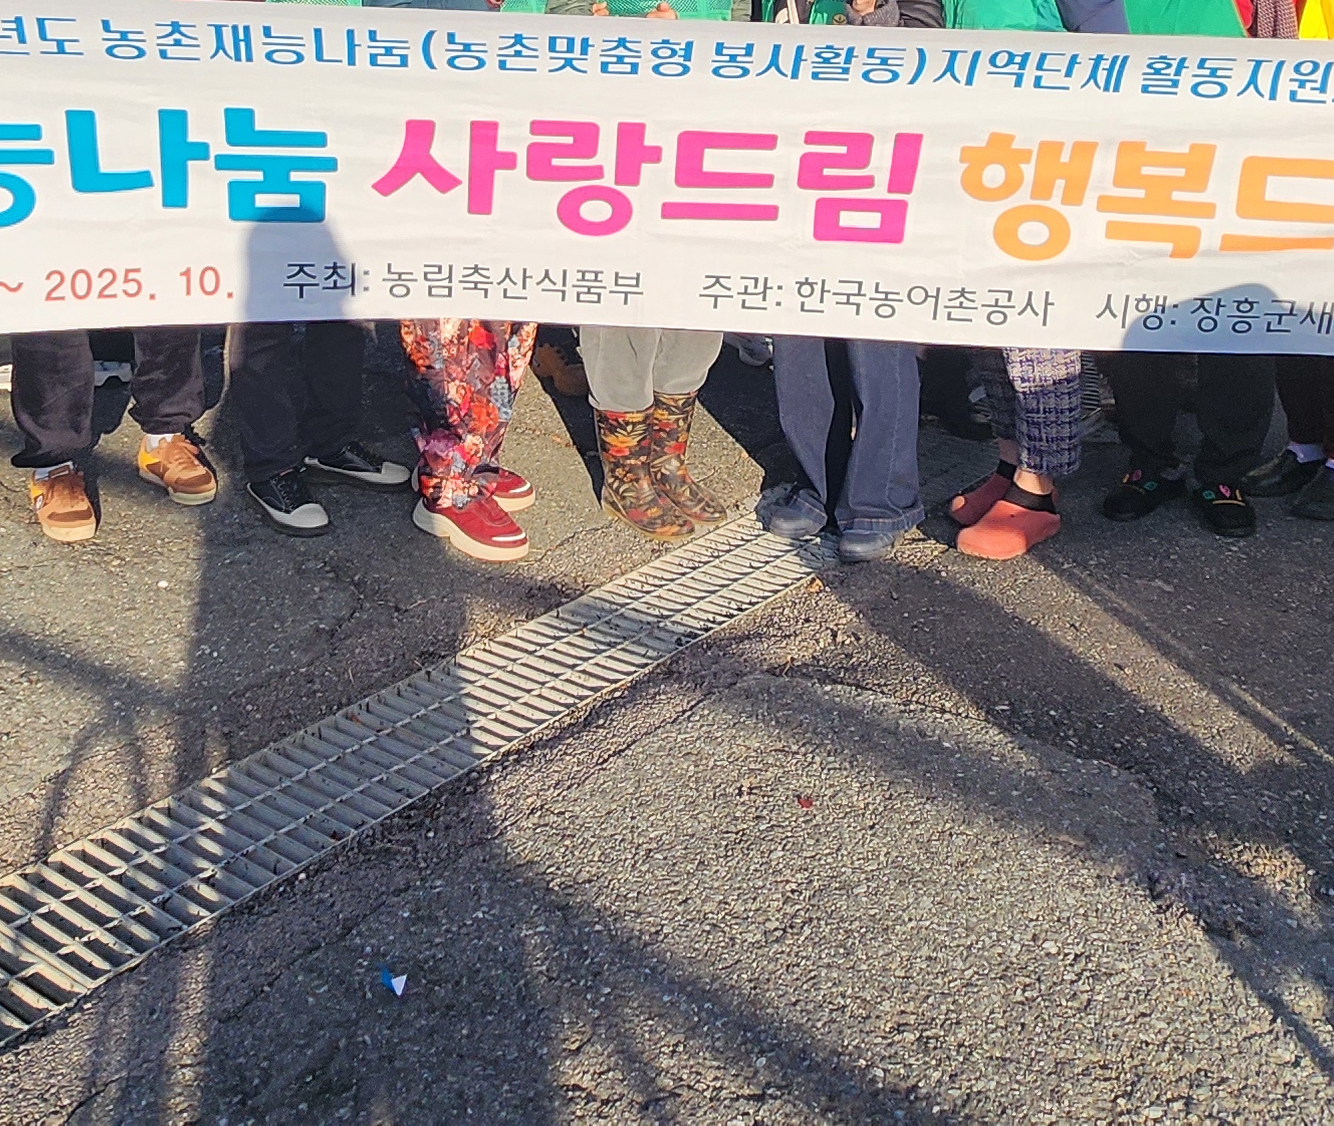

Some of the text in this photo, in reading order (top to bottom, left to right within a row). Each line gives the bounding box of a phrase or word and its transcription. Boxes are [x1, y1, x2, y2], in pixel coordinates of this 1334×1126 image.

[371, 119, 924, 245] 사랑드림
[44, 267, 158, 303] 2025.
[179, 266, 235, 301] 10.
[282, 261, 645, 305] 주최: 농림축산식품부
[698, 273, 1055, 328] 주관: 한국농어촌공사
[1095, 293, 1178, 331] 시행:
